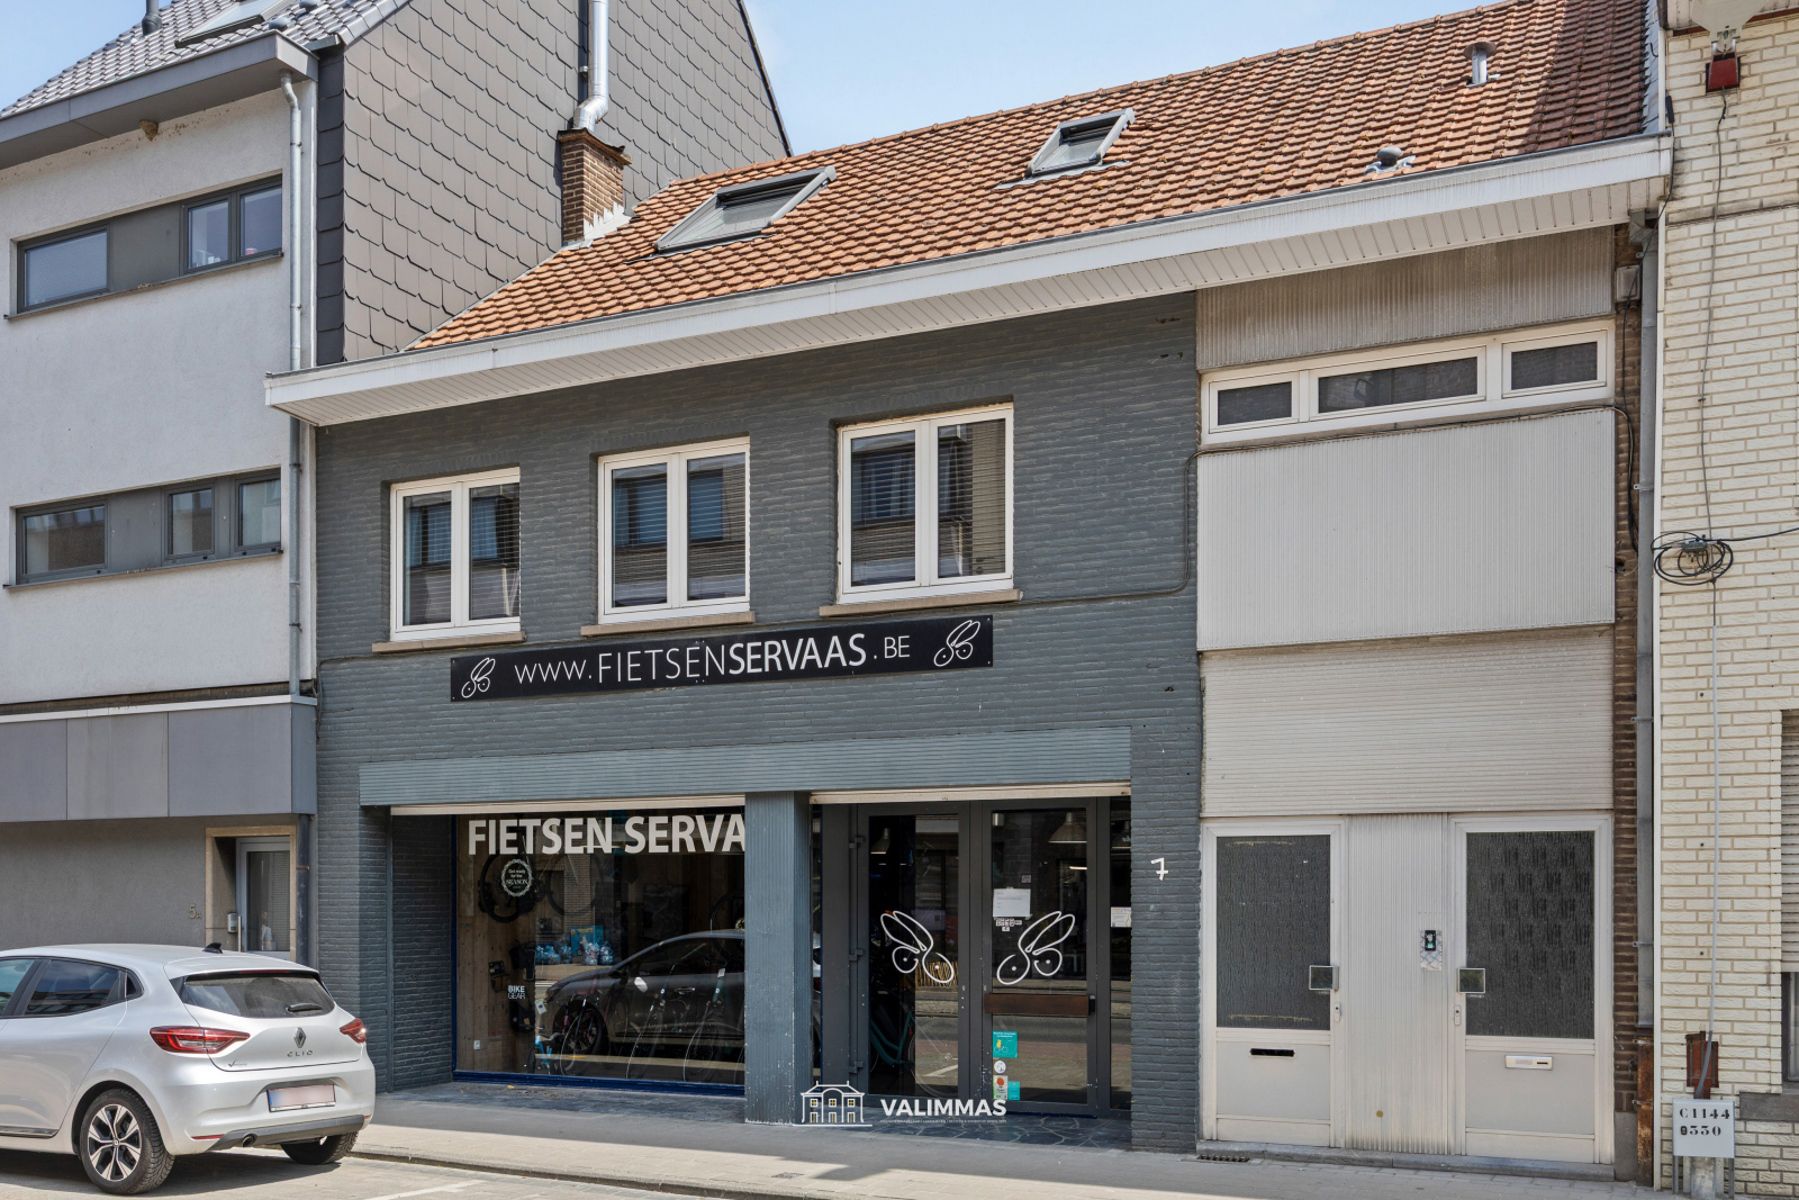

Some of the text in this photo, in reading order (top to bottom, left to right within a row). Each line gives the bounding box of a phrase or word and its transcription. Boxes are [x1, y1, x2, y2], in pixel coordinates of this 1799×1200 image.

[468, 817, 612, 855] FIETSEN
[1150, 857, 1169, 881] 7
[507, 985, 526, 993] BIKE
[507, 992, 526, 1000] GEAR
[287, 1050, 313, 1058] CLIO
[1679, 1108, 1730, 1119] C1144
